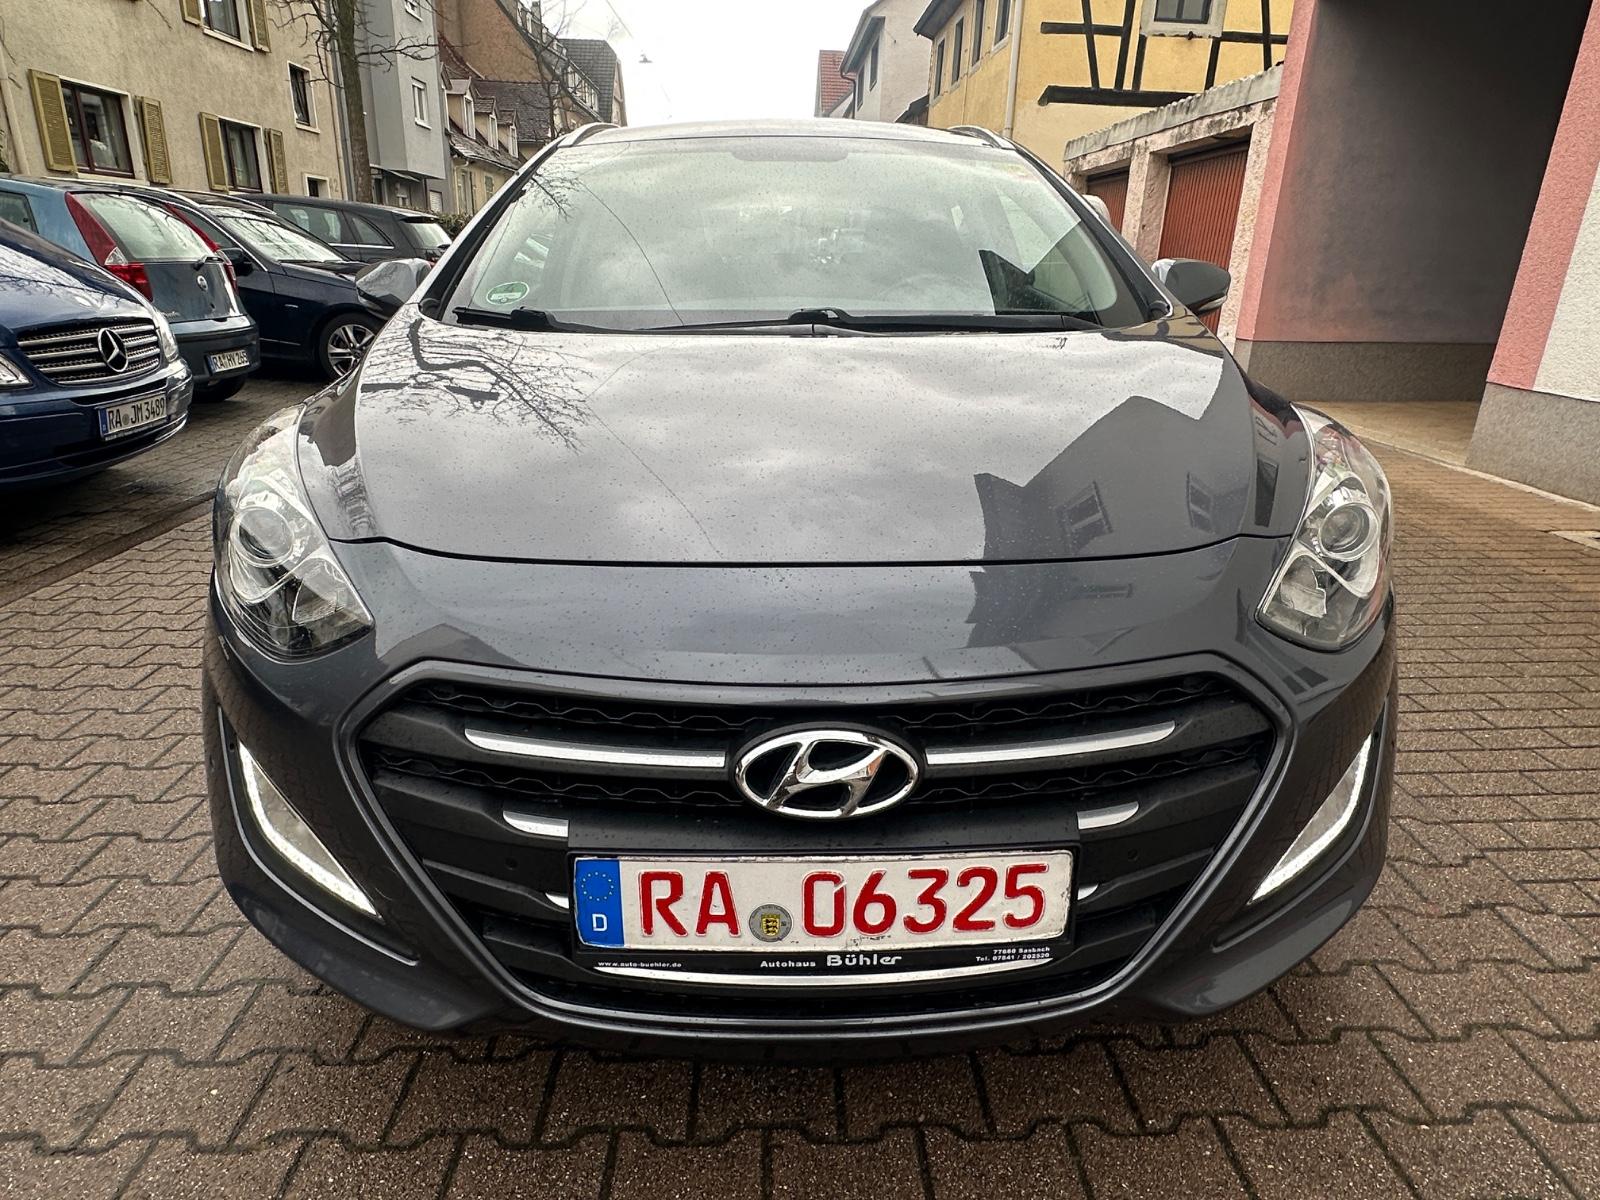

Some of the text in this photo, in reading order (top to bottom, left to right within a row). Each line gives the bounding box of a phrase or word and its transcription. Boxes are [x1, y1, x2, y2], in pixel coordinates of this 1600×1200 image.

[213, 355, 226, 369] RA
[108, 397, 165, 430] RA JM 3489
[638, 871, 741, 936] RA
[803, 863, 1049, 937] 06325
[592, 913, 608, 932] D
[1019, 946, 1050, 954] Sasbach
[760, 953, 902, 968] Autohaus Bühler
